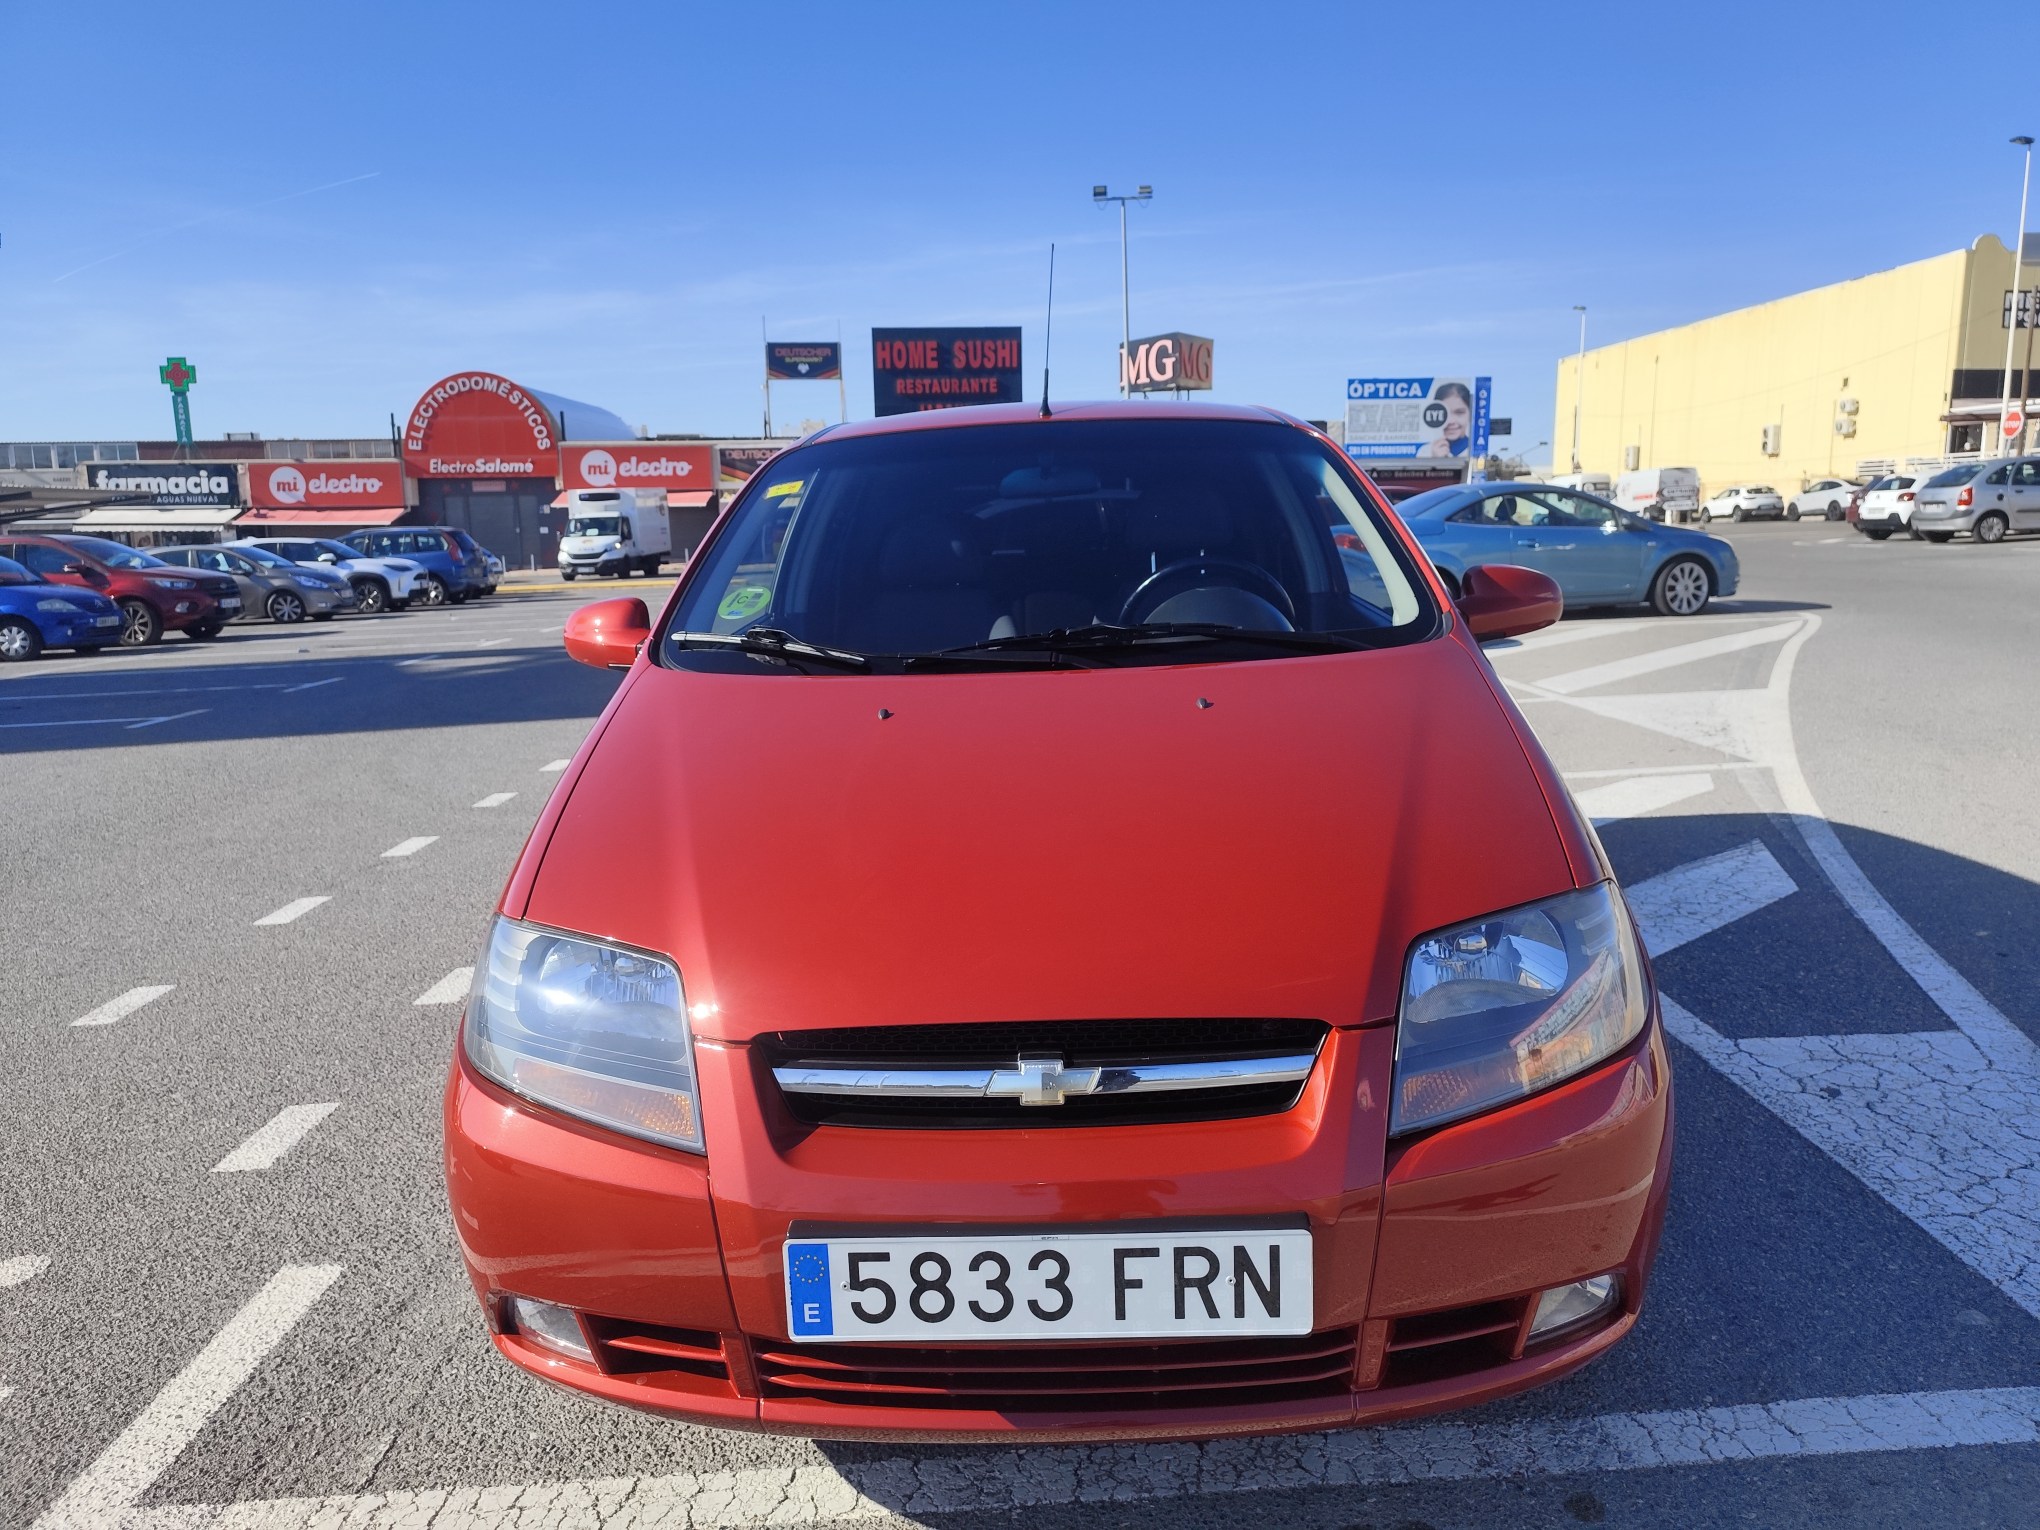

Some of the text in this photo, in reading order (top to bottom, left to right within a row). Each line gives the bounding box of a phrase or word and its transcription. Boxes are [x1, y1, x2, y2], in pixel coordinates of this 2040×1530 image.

[774, 347, 832, 357] DEUTSCHER
[876, 339, 1019, 369] HOME SUSHI
[1119, 338, 1177, 386] MG
[896, 377, 998, 395] RESTAURANTE
[1349, 379, 1423, 398] ÓPTICA
[177, 396, 188, 444] FARMACIA
[408, 376, 551, 451] ELECTRODOMÉSTICOS
[1425, 409, 1446, 422] EYE
[2004, 420, 2020, 430] STOP
[429, 457, 534, 474] ElectroSalomé
[588, 456, 692, 477] mi electro
[96, 469, 230, 494] farmacia
[276, 472, 383, 494] mi electro
[156, 495, 219, 504] AGUAS NUEVAS
[846, 1243, 1282, 1325] 5833 FRN
[803, 1302, 821, 1323] E
